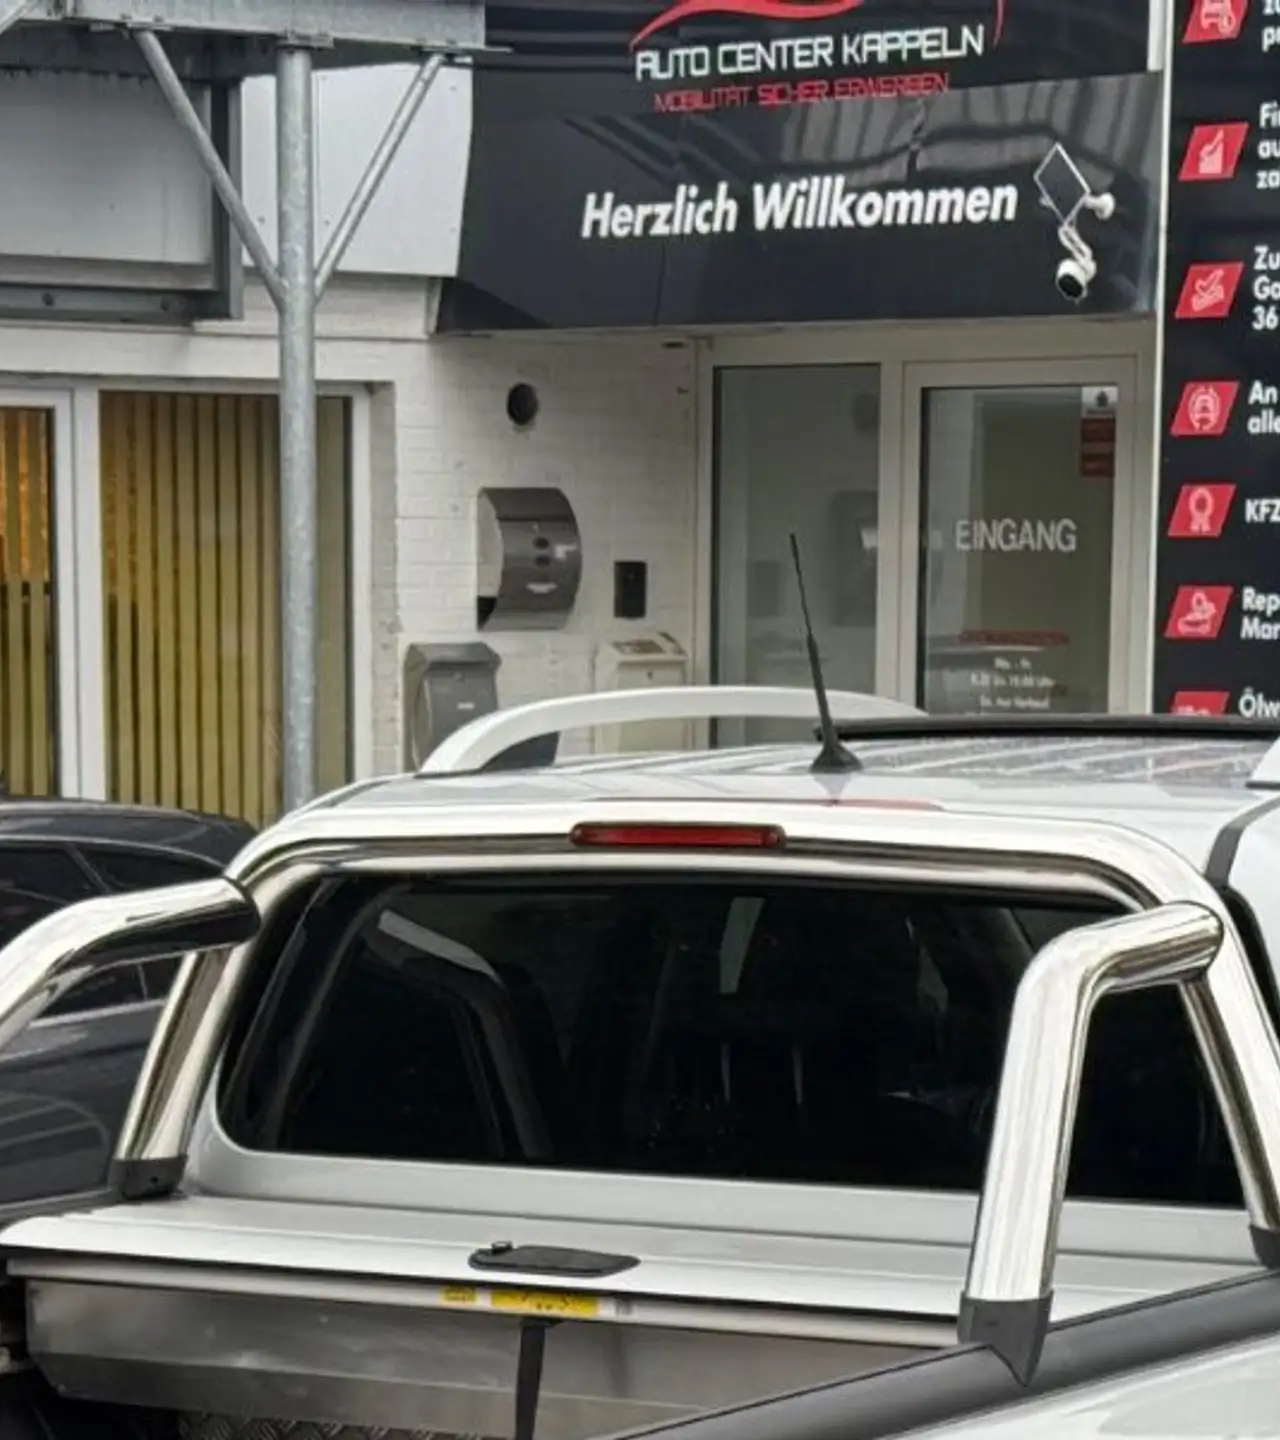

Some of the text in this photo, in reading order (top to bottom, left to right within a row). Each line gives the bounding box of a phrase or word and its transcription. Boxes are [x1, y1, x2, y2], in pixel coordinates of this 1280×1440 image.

[636, 25, 984, 81] AUTO CENTER KAPPELN
[654, 72, 949, 112] MOBILITÄT SICHER ERWERBEN
[582, 176, 1017, 239] Herzlich Willkommen
[1252, 307, 1276, 330] 36
[1249, 380, 1277, 404] An
[955, 519, 1077, 553] EINGANG
